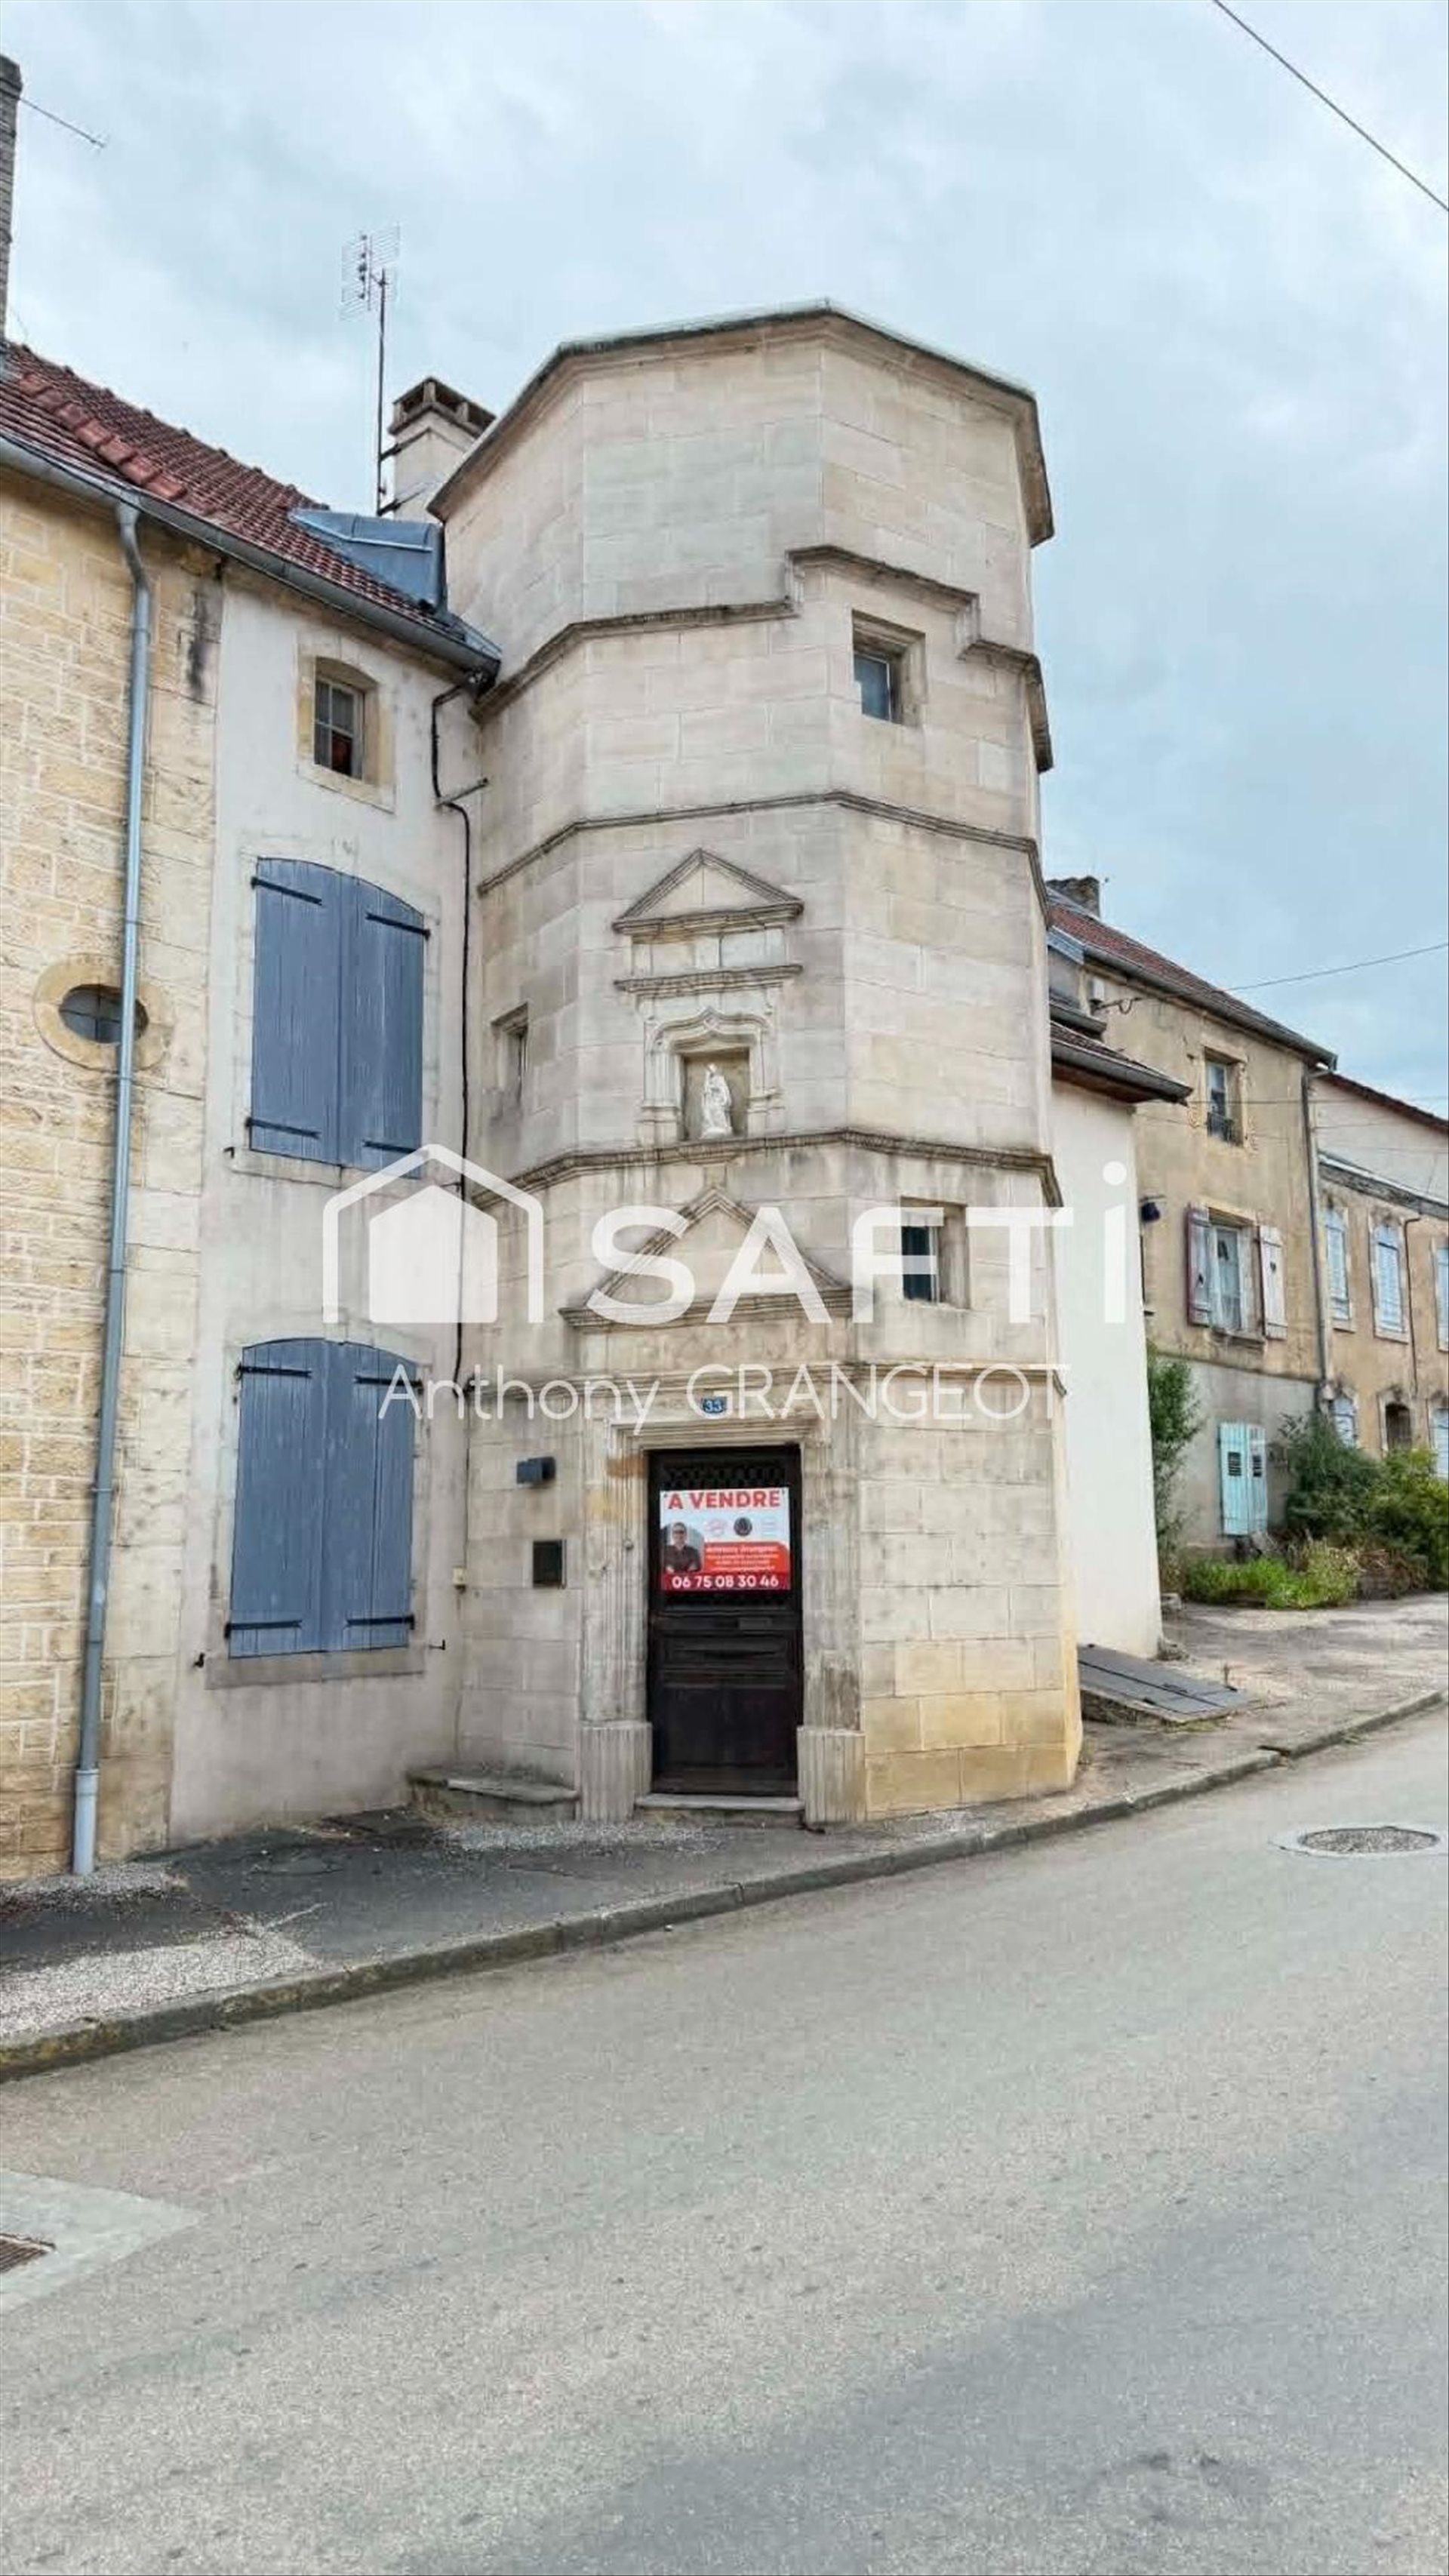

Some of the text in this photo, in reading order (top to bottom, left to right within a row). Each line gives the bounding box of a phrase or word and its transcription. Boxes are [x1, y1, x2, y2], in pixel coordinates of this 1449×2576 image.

[705, 1399, 723, 1413] 33
[689, 1491, 781, 1509] VENDRE
[672, 1574, 779, 1588] 06 75 08 30 46
